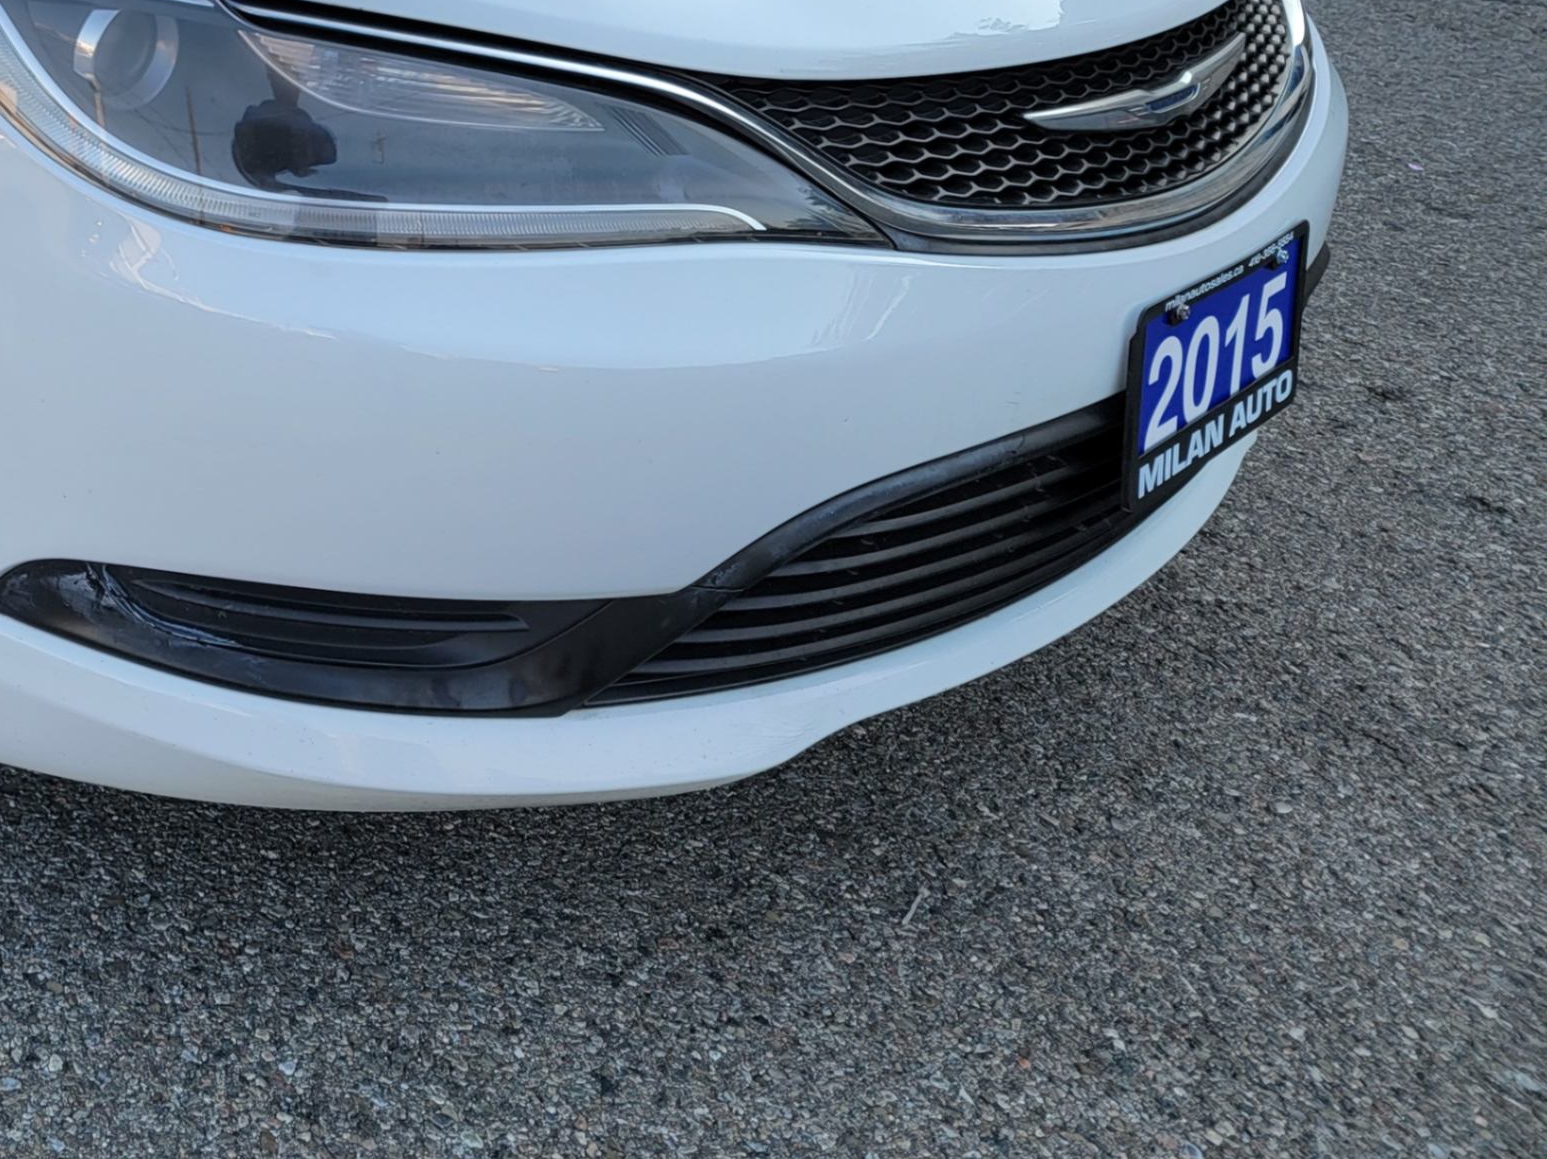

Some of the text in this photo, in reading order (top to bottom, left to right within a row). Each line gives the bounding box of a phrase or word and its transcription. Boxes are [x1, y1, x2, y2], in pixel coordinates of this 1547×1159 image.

[1138, 369, 1293, 499] MILAN AUTO
[1144, 271, 1287, 453] 2015
